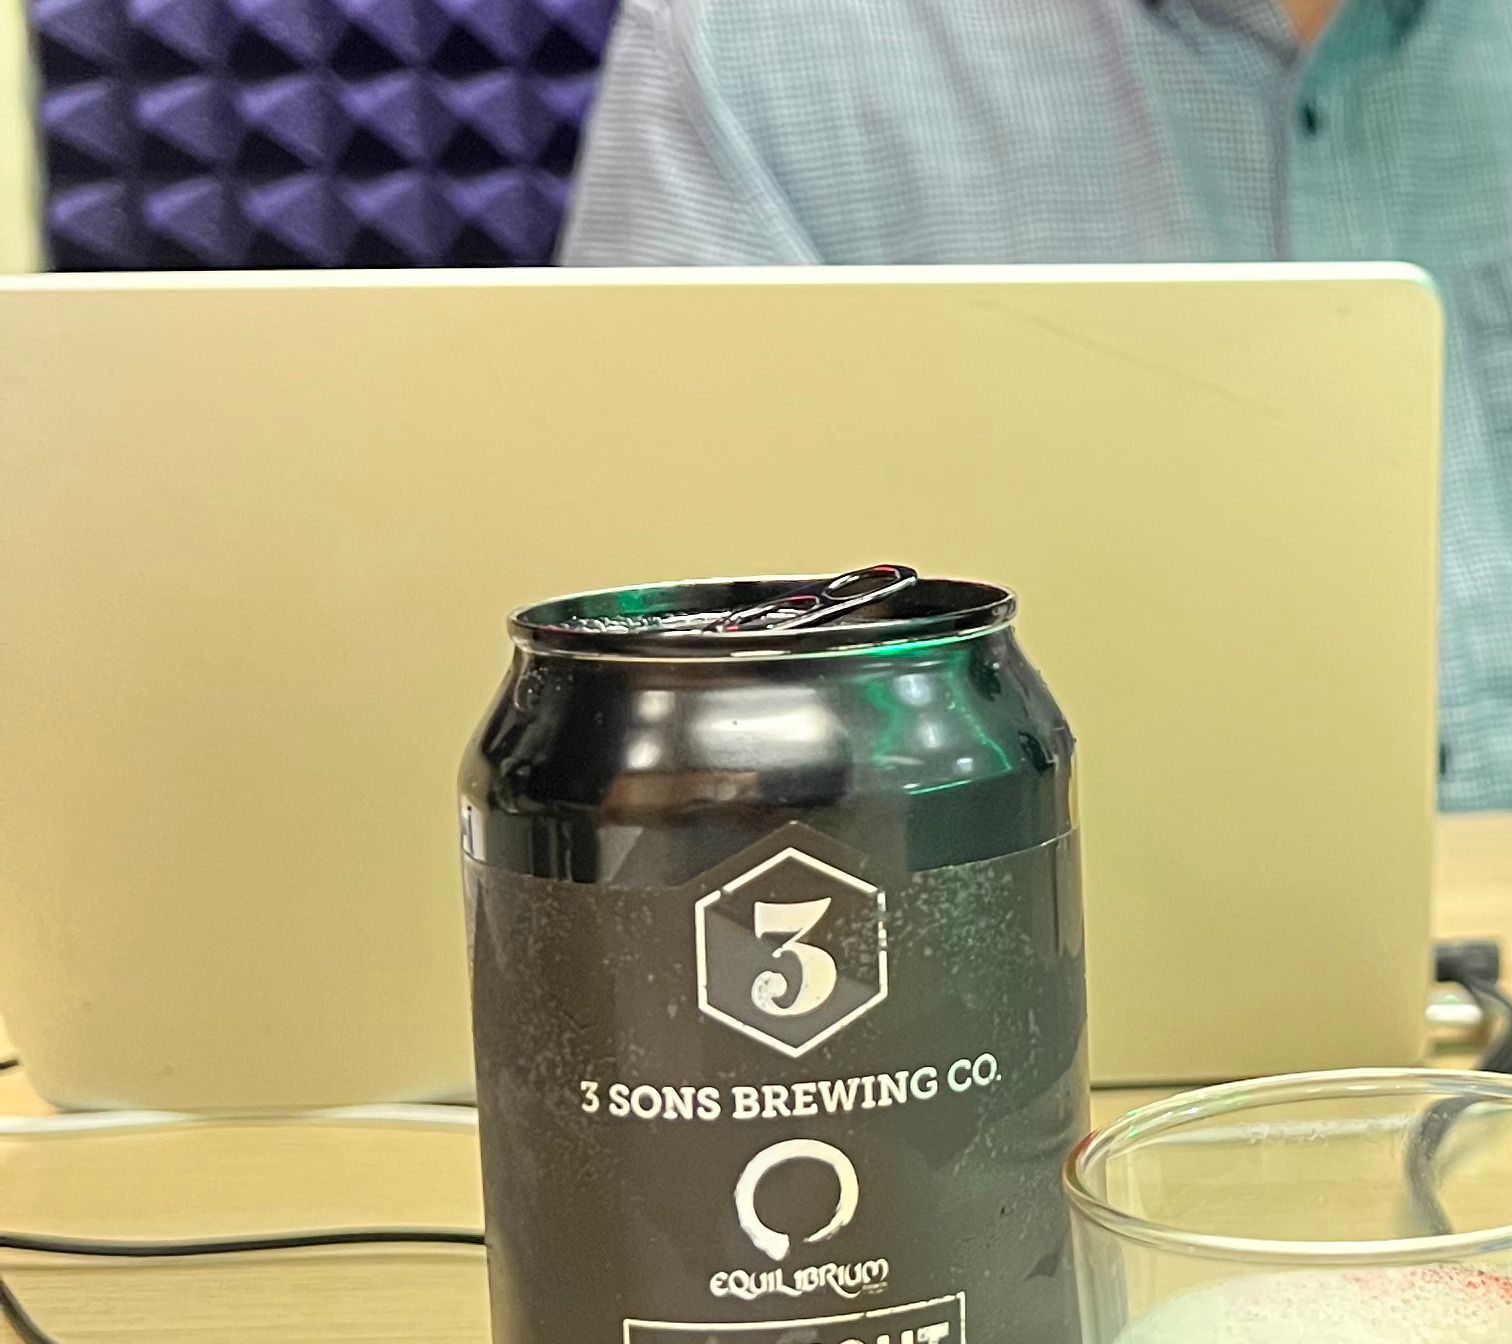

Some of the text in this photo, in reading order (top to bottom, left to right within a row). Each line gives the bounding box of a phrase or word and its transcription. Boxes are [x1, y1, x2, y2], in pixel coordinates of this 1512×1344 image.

[751, 897, 838, 1016] 3
[580, 1052, 1003, 1121] 3 SONS BREWING CO.
[709, 1258, 889, 1300] EQUILIBRIUM
